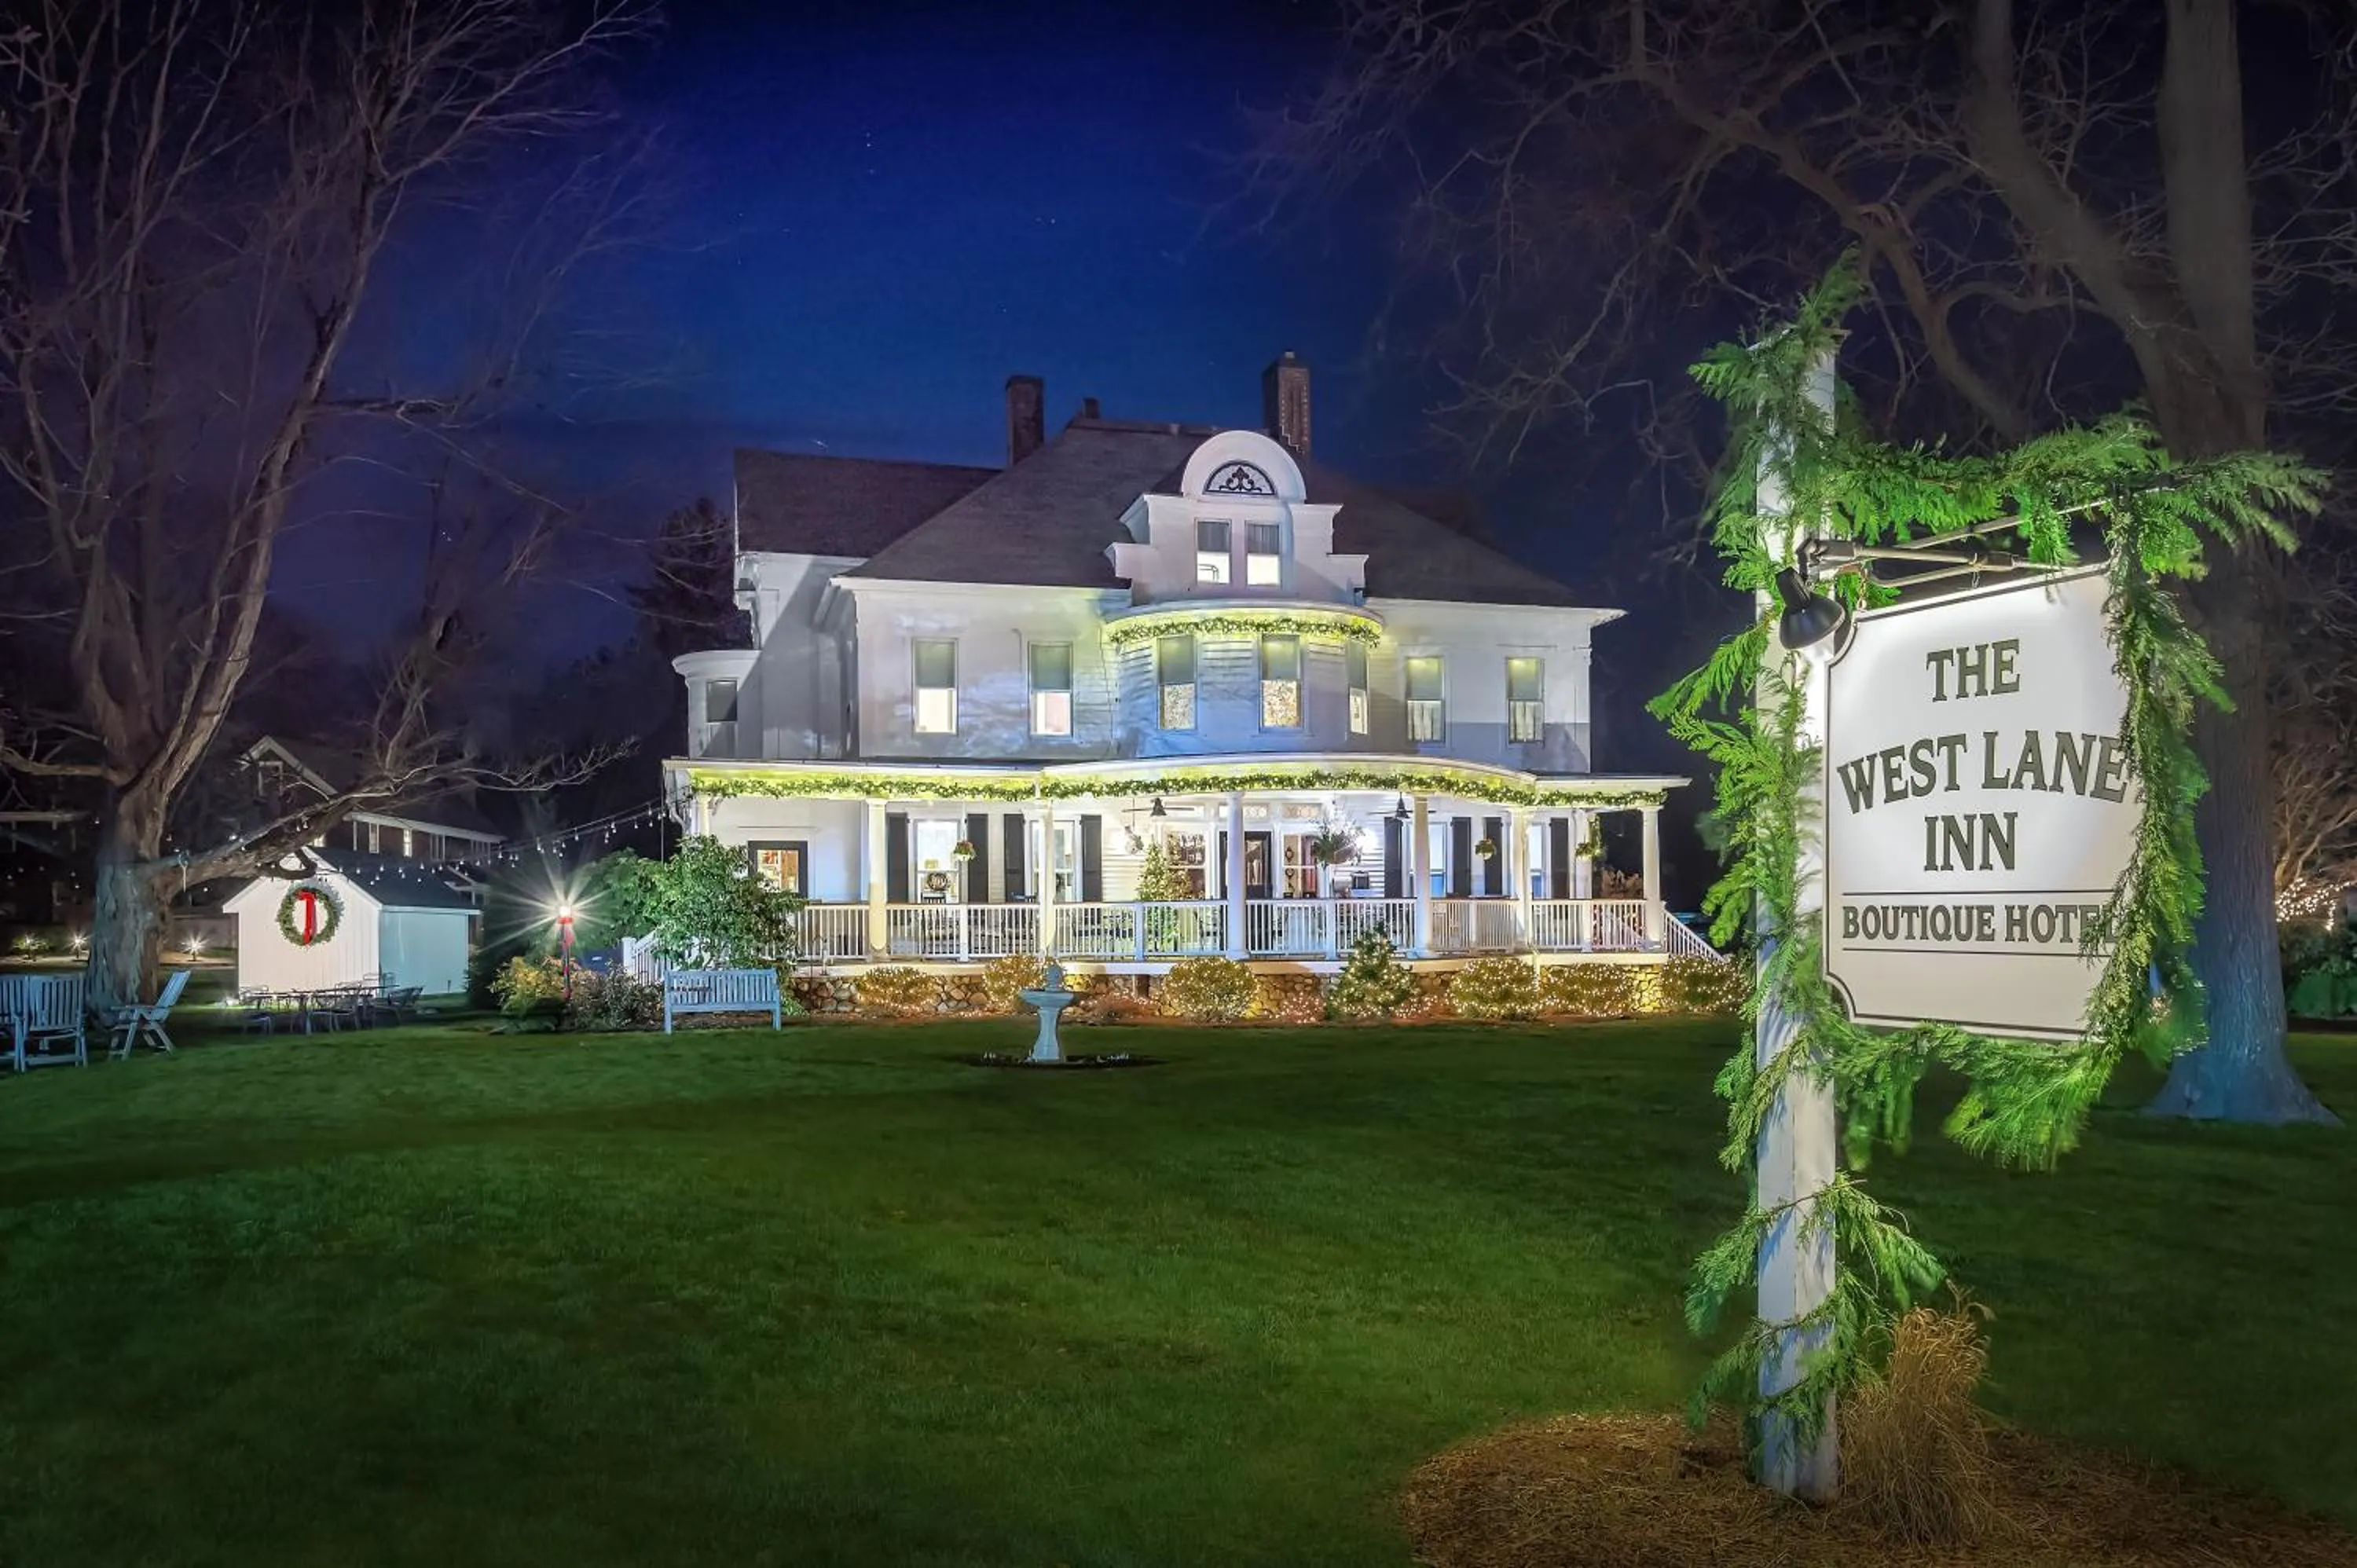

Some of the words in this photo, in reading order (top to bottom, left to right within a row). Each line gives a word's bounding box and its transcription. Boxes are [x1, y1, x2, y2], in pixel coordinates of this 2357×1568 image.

[1926, 639, 2021, 702] THE
[1837, 733, 1967, 814] WEST
[1981, 730, 2128, 803] LANE
[1923, 812, 2018, 871] INN
[1842, 905, 1996, 942] BOUTIQUE
